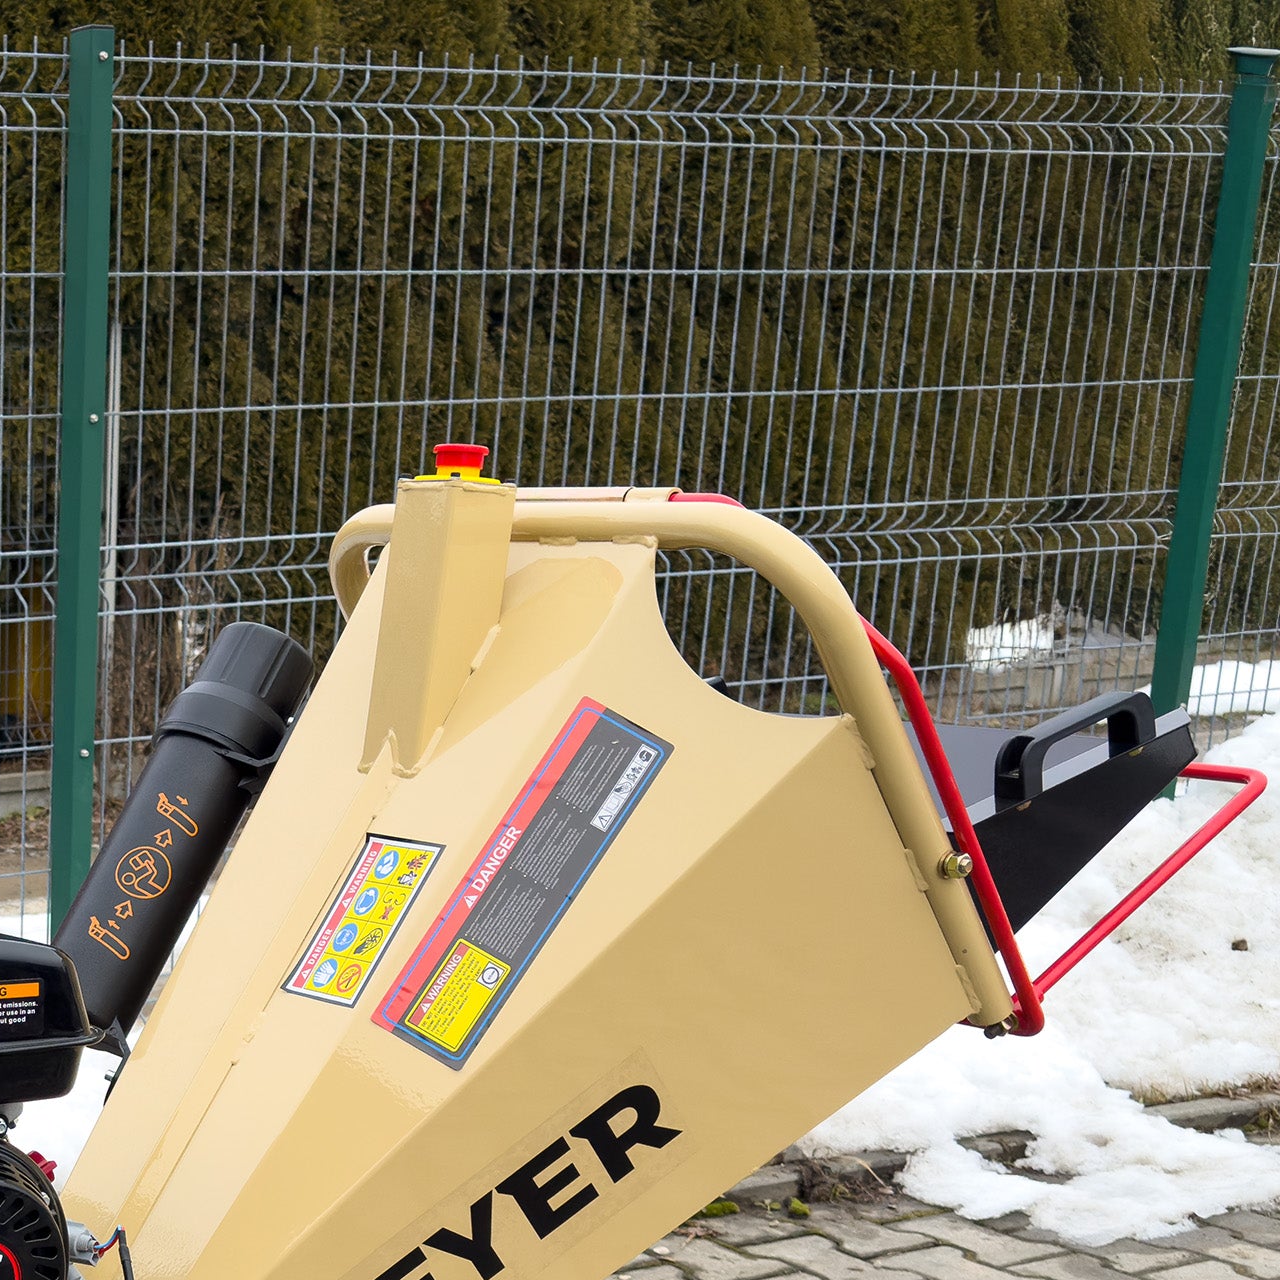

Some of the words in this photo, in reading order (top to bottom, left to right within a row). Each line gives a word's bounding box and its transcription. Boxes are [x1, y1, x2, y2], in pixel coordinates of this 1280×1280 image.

[347, 850, 378, 894] WARNING
[469, 824, 522, 893] DANGER
[307, 927, 333, 965] DANGER
[426, 953, 462, 1001] WARNING
[8, 1016, 26, 1024] good
